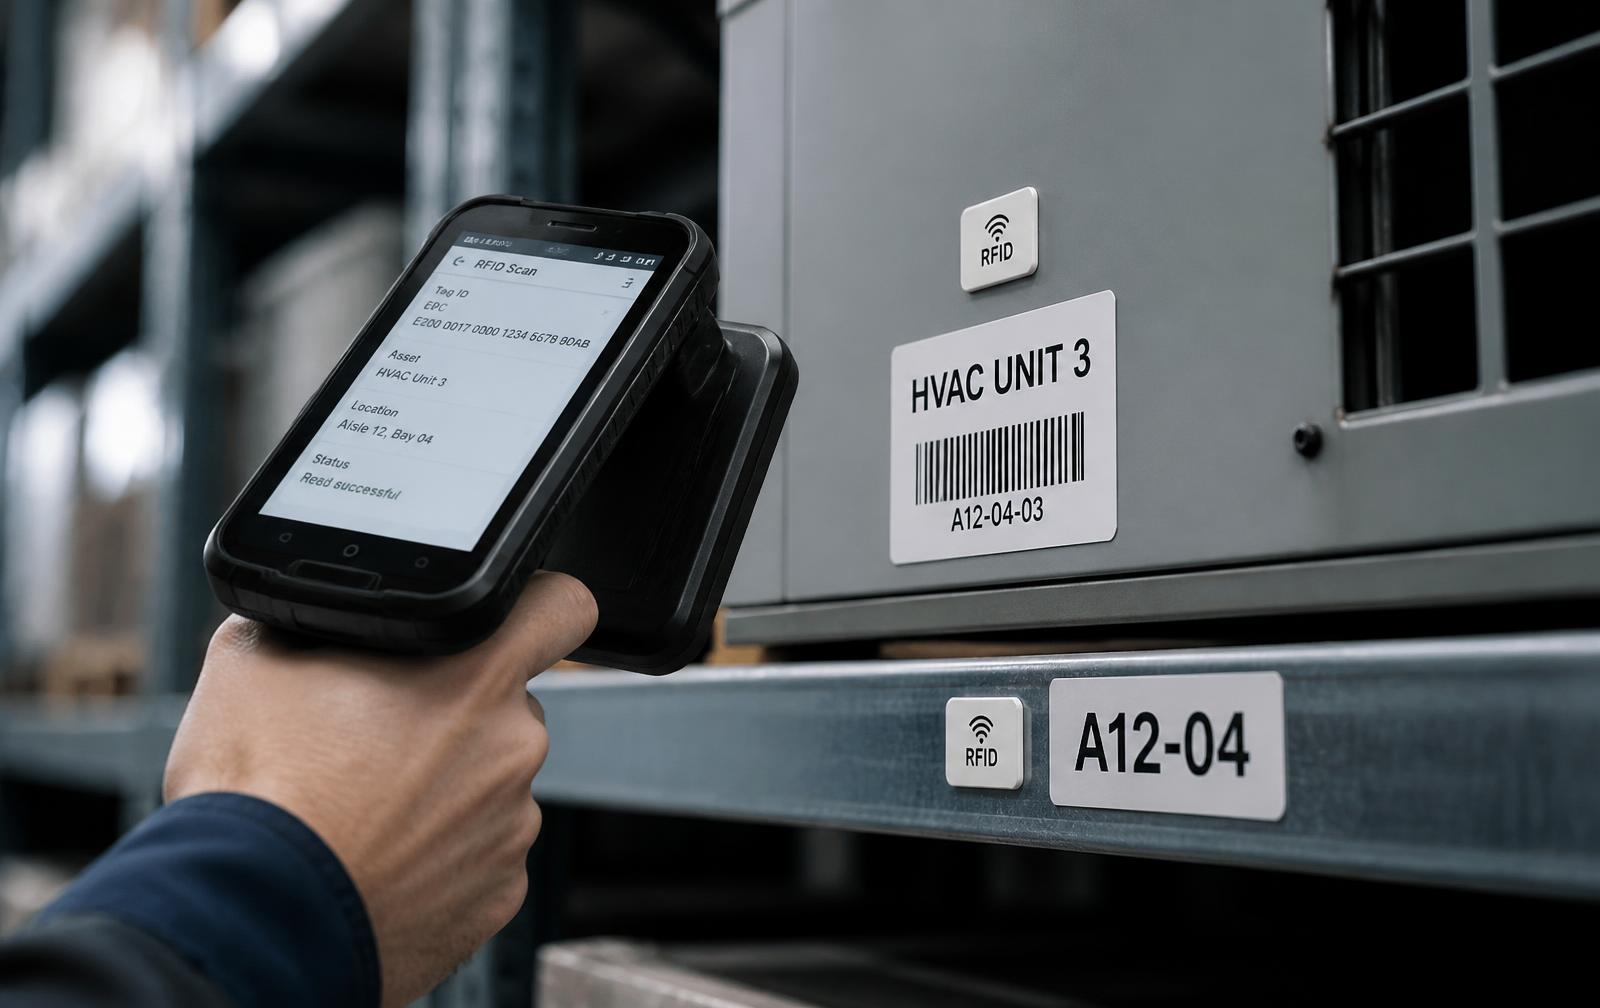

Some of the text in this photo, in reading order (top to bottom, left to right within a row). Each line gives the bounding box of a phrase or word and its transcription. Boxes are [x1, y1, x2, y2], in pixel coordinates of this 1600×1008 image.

[980, 241, 1014, 268] RFID
[474, 259, 538, 277] RFID Scan
[435, 286, 469, 298] Tag ID
[423, 300, 448, 312] EPC
[412, 316, 442, 329] E200
[443, 321, 472, 332] 0017
[471, 325, 500, 336] 0000
[502, 328, 529, 340] 1234
[387, 349, 421, 363] Asset
[376, 367, 448, 388] HVAC Unit 3
[911, 336, 1092, 414] HVAC UNIT 3
[350, 400, 399, 418] Location
[336, 418, 434, 445] Aisle 12, Bay 04
[311, 453, 351, 470] Status
[299, 472, 402, 501] Read successful
[950, 495, 1045, 533] A12-04-03
[1073, 710, 1251, 778] A12-04
[965, 747, 998, 768] RFID
